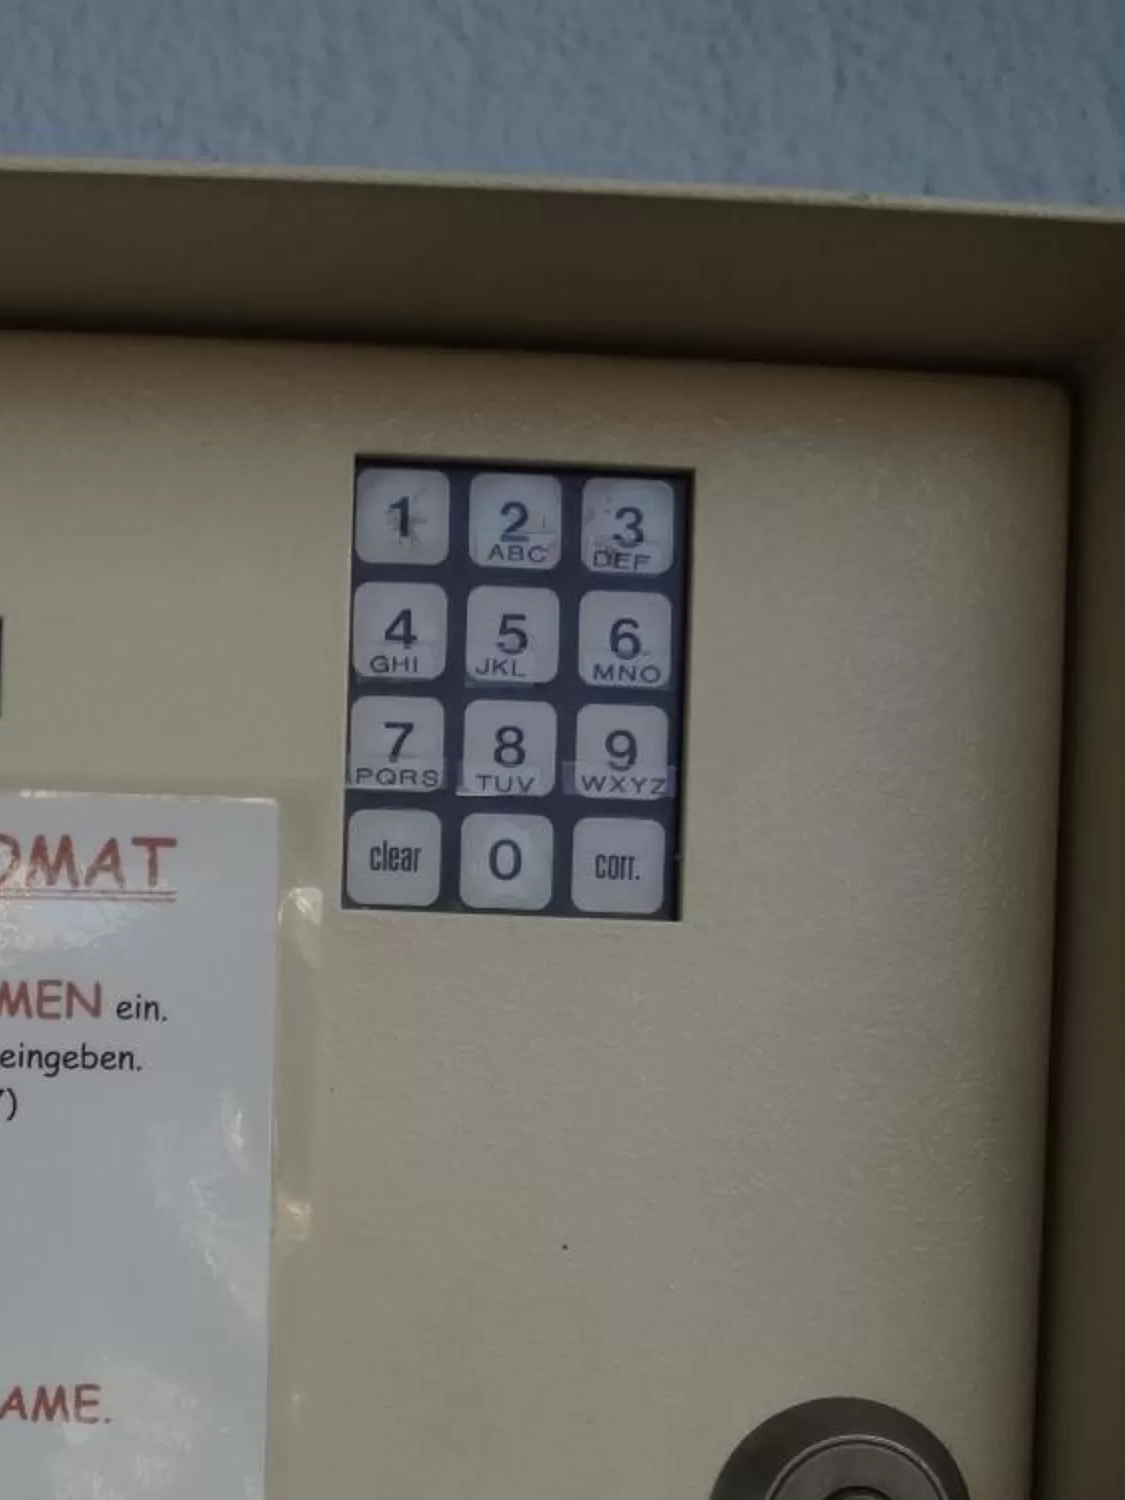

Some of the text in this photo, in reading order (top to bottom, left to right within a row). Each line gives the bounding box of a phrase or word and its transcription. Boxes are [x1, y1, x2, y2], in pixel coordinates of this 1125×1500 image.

[389, 496, 410, 538] 1
[500, 502, 530, 542] 2
[612, 506, 645, 549] 3
[487, 546, 548, 563] ABC
[592, 550, 652, 570] DEF
[384, 608, 418, 649] 4
[497, 613, 528, 655] 5
[609, 618, 641, 659] 6
[369, 655, 419, 673] GHI
[476, 659, 525, 677] JKL
[592, 664, 661, 683] MNO
[384, 722, 414, 763] 7
[493, 726, 525, 768] 8
[604, 730, 637, 772] 9
[356, 768, 439, 786] PQRS
[478, 775, 535, 793] TUV
[581, 776, 667, 795] WXYZ
[369, 841, 422, 872] clear
[489, 840, 521, 880] 0
[595, 852, 641, 880] corr.
[116, 996, 169, 1022] ein.
[0, 1045, 143, 1076] eingeben.
